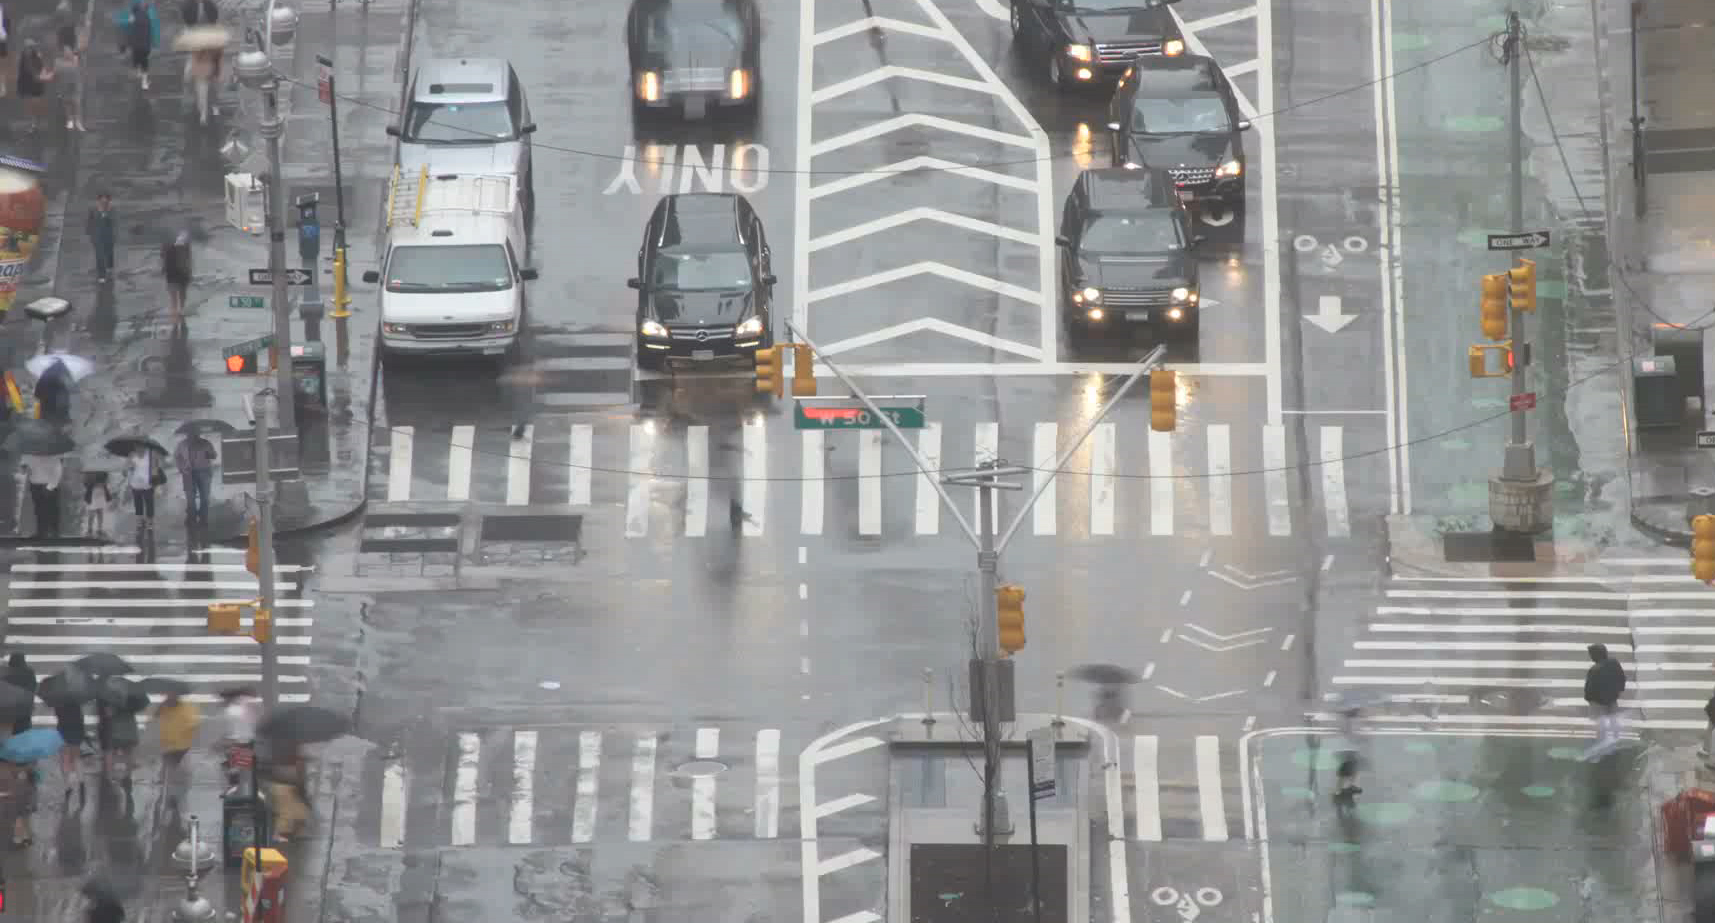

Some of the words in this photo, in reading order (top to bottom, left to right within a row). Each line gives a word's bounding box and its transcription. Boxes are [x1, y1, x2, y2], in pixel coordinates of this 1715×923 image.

[601, 143, 769, 195] ONLY
[1495, 239, 1512, 247] ONE
[1521, 235, 1541, 245] WAY
[843, 409, 872, 425] 50
